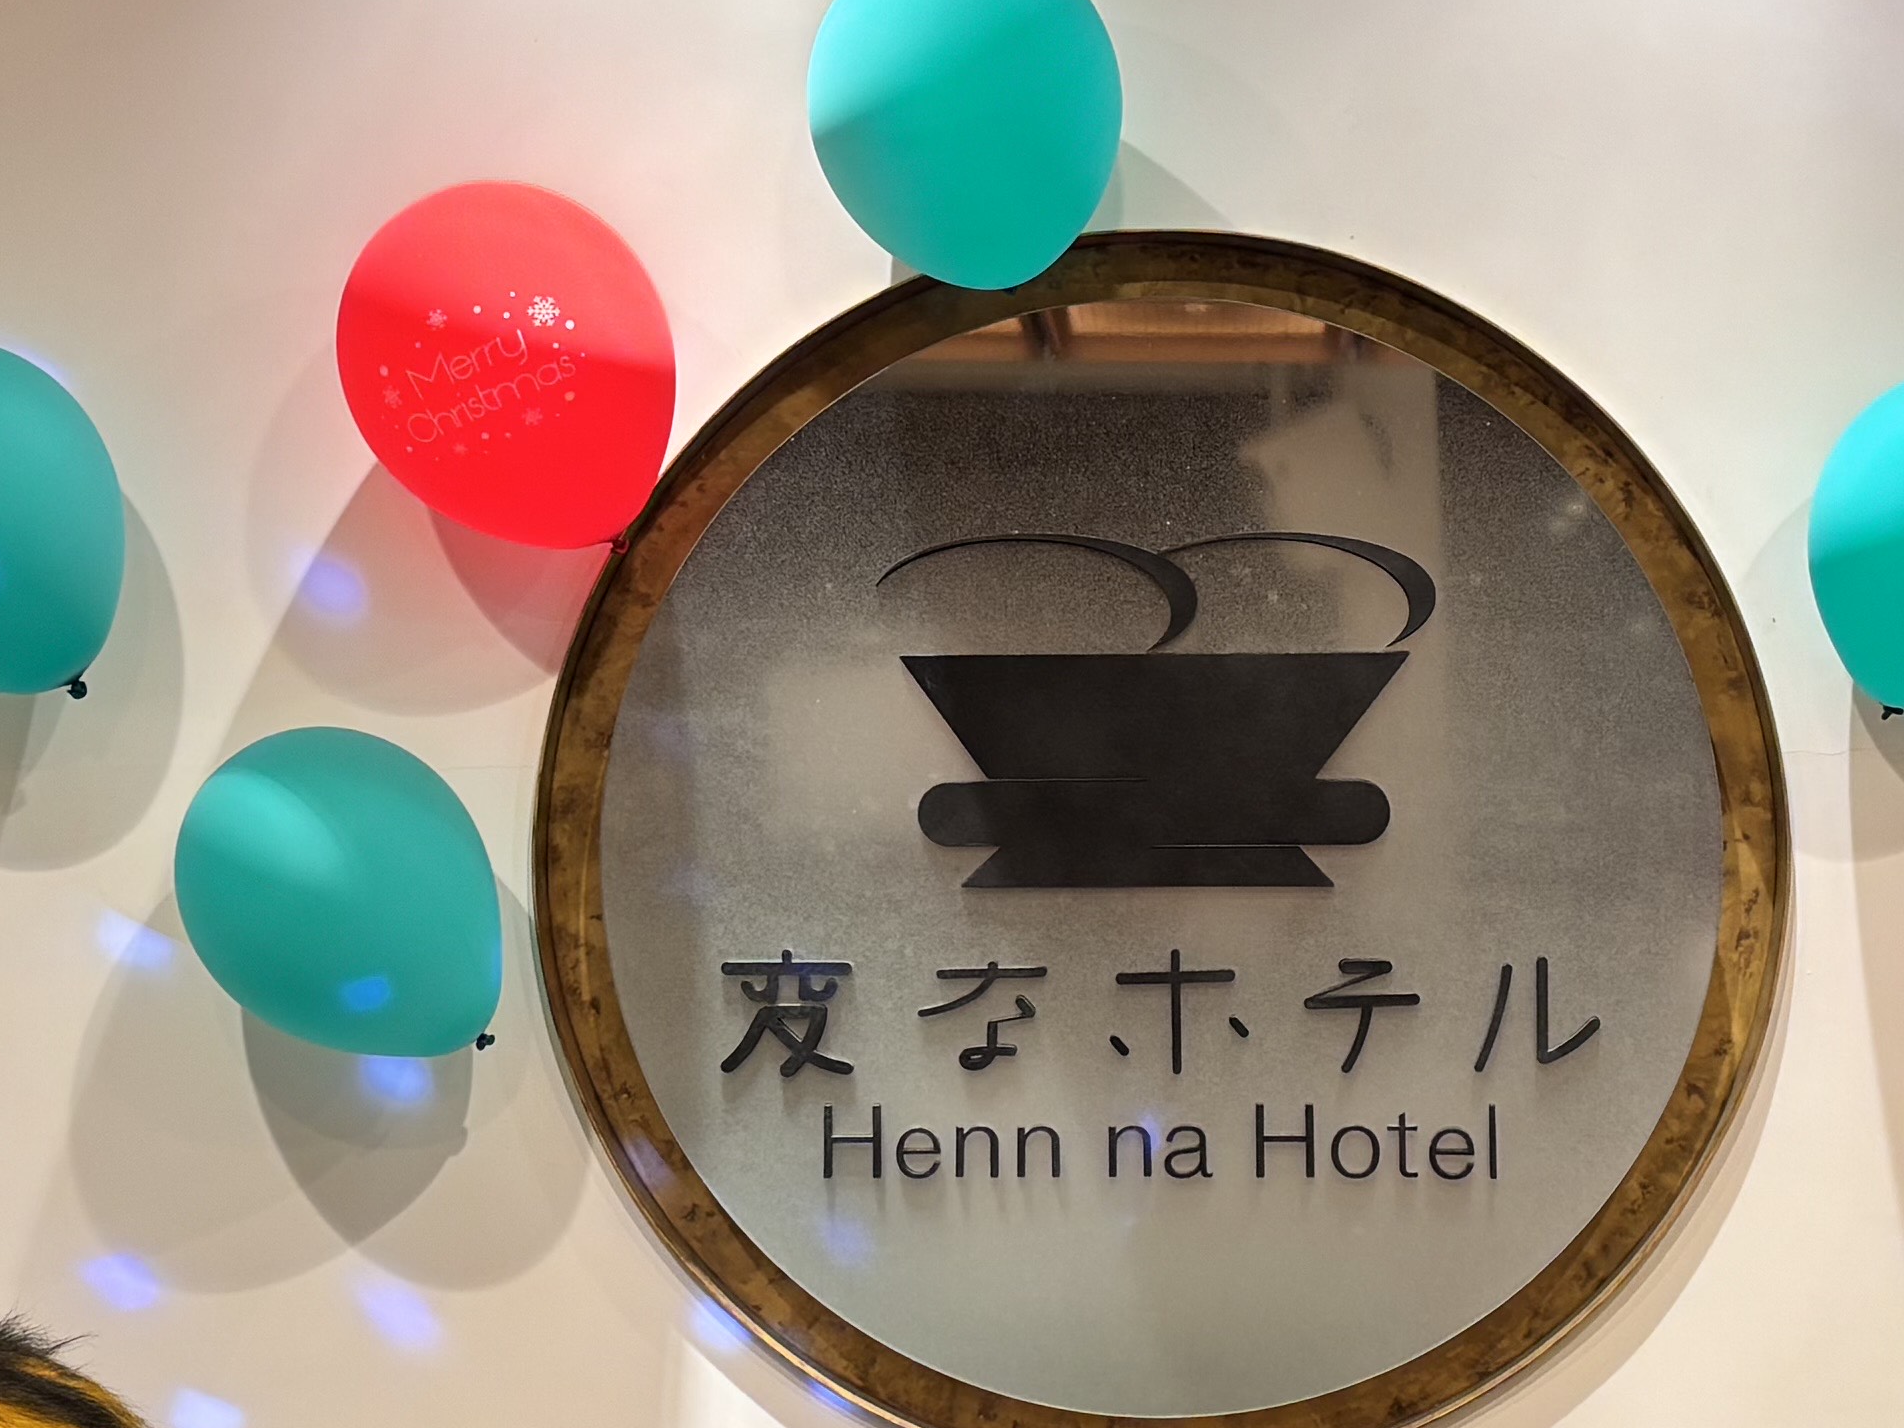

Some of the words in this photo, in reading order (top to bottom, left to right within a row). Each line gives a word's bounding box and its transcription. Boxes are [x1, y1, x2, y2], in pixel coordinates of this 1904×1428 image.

[406, 329, 528, 400] Merry
[407, 355, 576, 443] Christmas
[721, 949, 1600, 1075] 変なホテル
[823, 1104, 1060, 1178] Henn
[1108, 1121, 1213, 1178] na
[1255, 1102, 1497, 1179] Hotel
